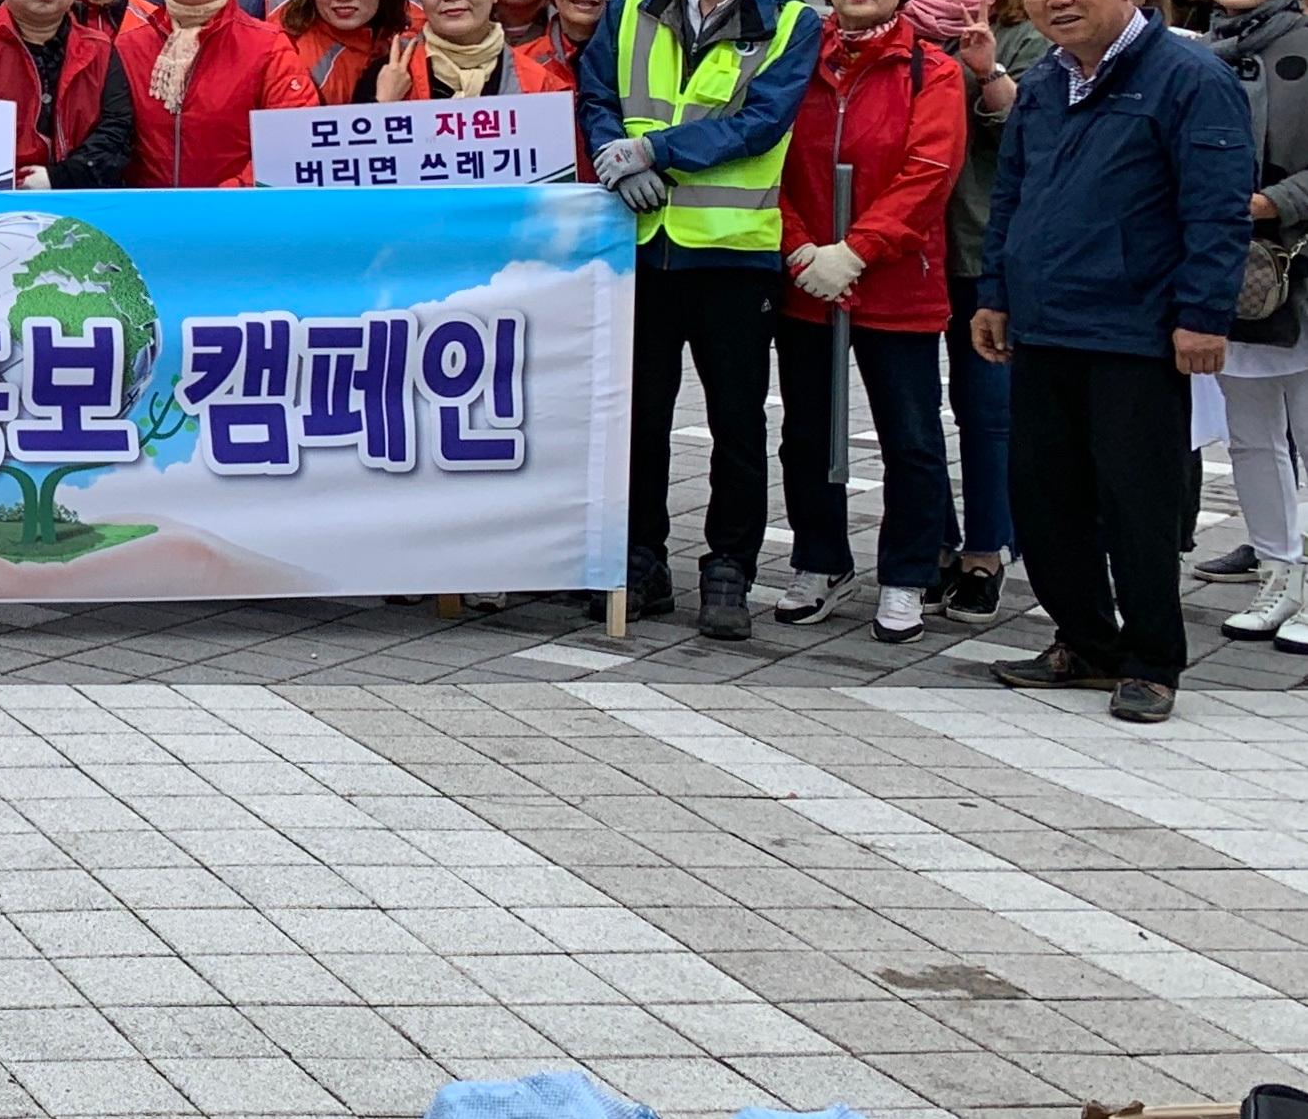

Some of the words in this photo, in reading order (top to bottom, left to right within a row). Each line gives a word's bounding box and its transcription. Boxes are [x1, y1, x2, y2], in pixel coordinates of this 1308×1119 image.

[311, 115, 414, 148] 모으면
[435, 109, 517, 140] 자원!
[295, 155, 398, 187] 버리면
[420, 148, 537, 181] 쓰레기!
[184, 318, 517, 465] 캠페인
